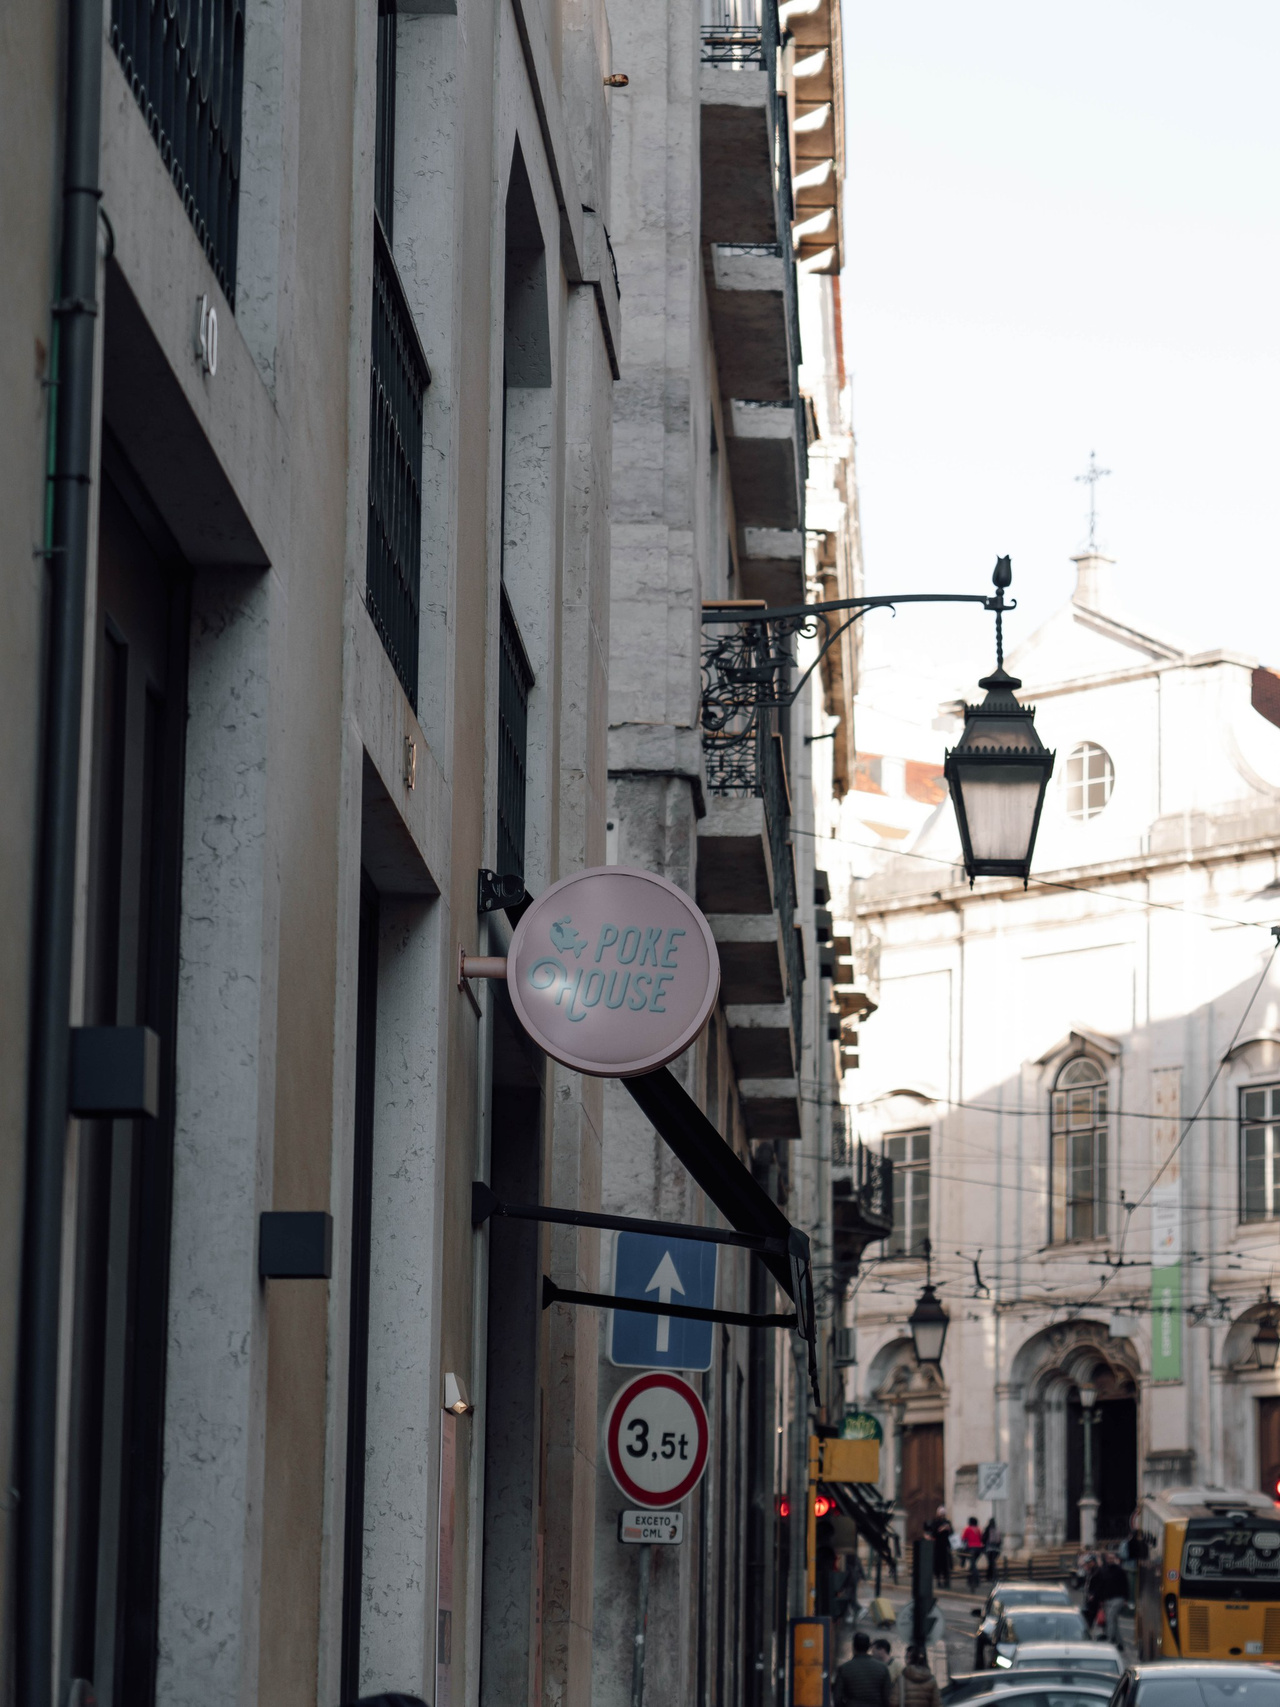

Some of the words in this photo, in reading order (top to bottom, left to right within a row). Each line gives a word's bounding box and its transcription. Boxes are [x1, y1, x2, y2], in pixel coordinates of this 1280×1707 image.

[593, 923, 686, 969] POKE
[527, 955, 674, 1023] HOUSE
[626, 1418, 688, 1462] 3,5t
[635, 1516, 671, 1526] EXCETO
[643, 1528, 662, 1538] CML
